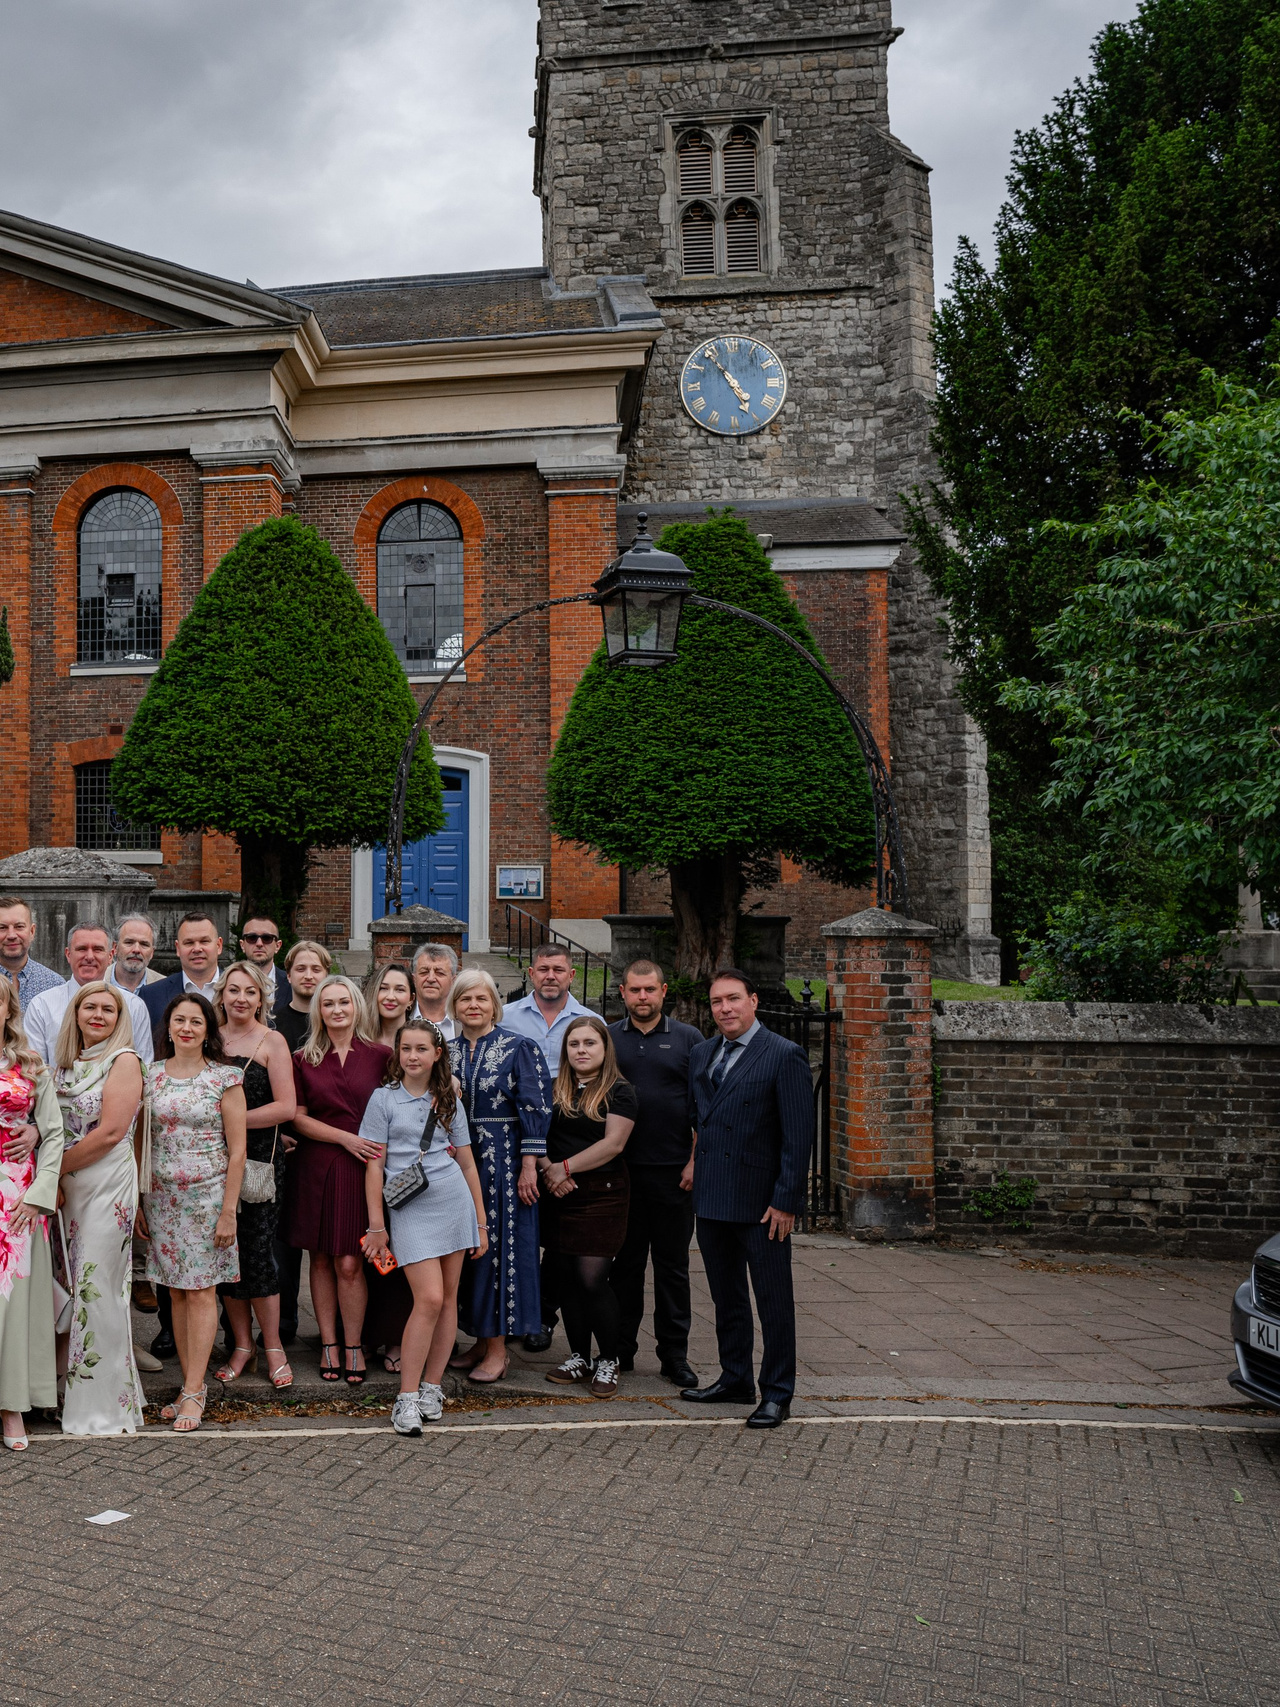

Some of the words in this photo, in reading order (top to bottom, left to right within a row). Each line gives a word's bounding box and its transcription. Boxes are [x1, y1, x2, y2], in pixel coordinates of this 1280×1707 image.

[725, 341, 739, 353] XII
[691, 362, 705, 372] X
[760, 359, 774, 370] II
[687, 381, 701, 392] IX
[767, 377, 780, 388] III
[692, 396, 707, 413] VIII
